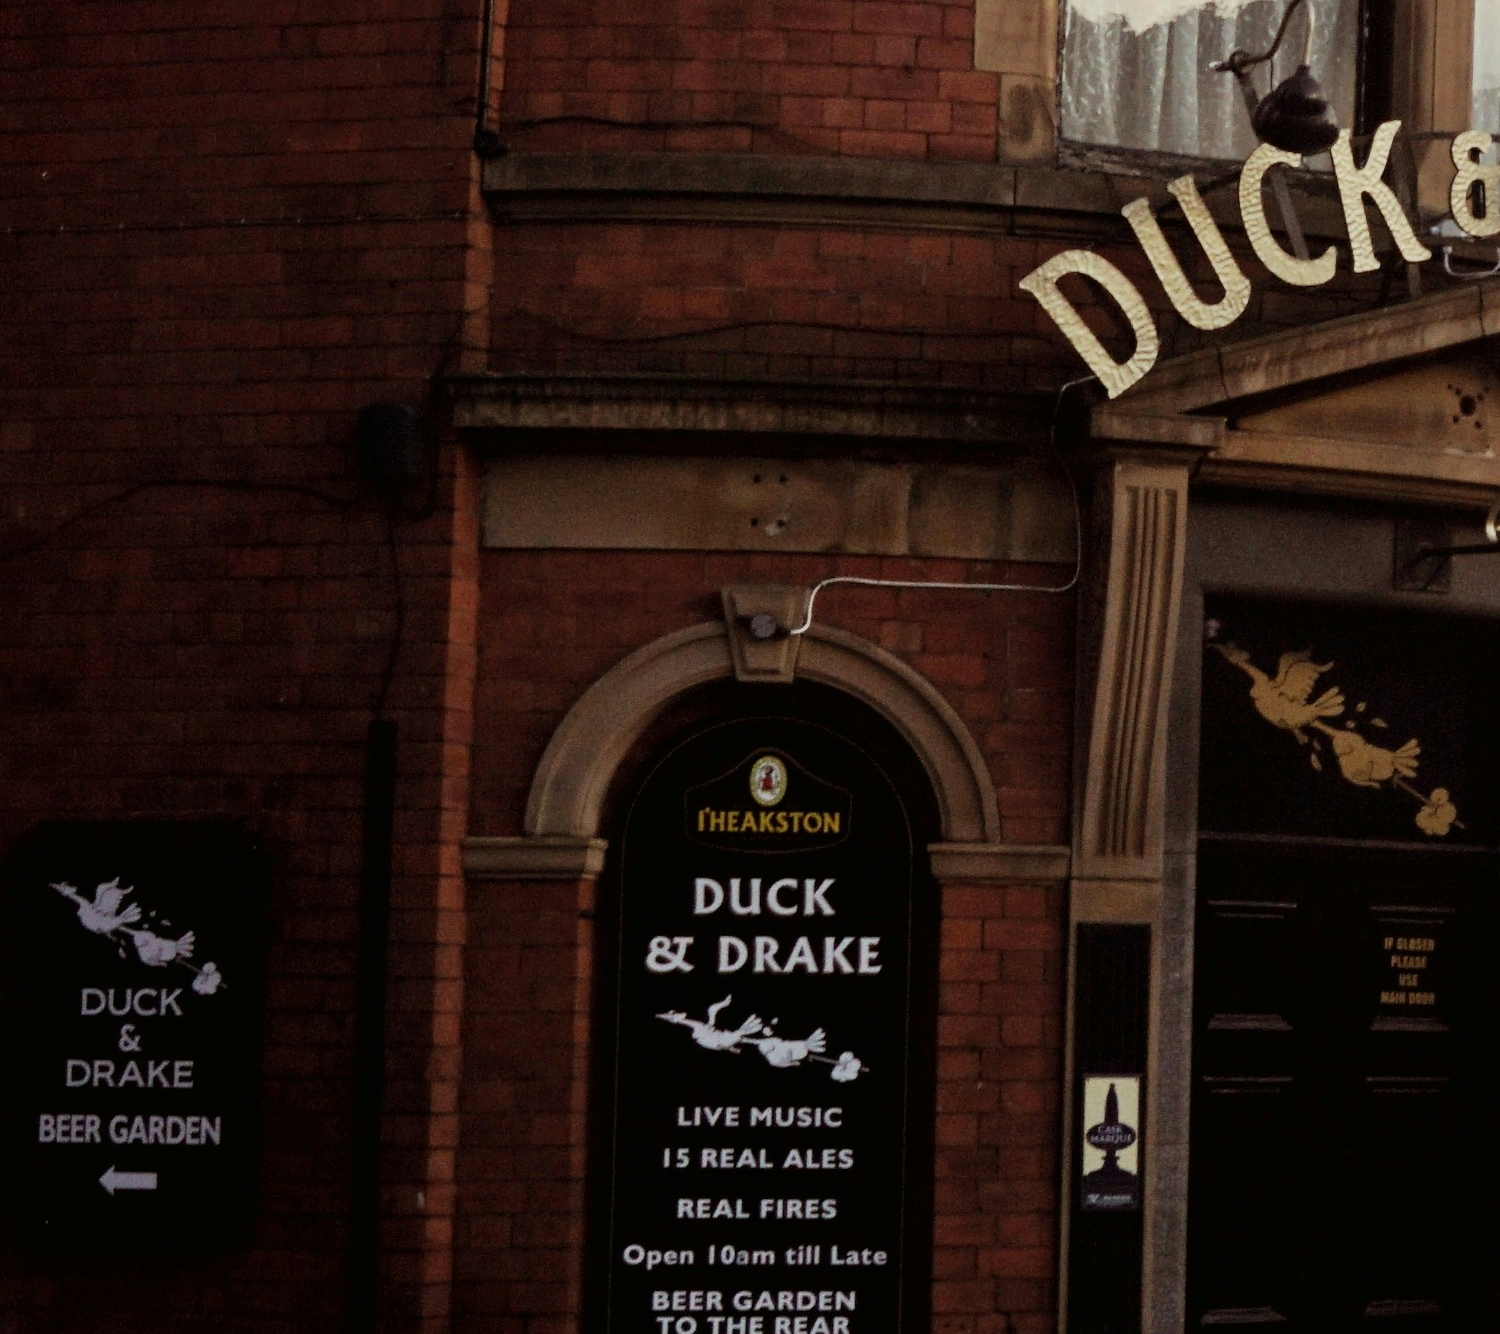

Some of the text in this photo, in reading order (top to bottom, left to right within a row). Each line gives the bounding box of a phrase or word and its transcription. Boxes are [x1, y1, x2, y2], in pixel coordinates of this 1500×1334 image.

[1019, 120, 1432, 399] DUCK
[697, 806, 841, 834] THEAKSTON
[692, 876, 836, 916] DUCK
[644, 934, 883, 975] & DRAKE
[1391, 955, 1427, 969] PLEASE
[1399, 973, 1419, 987] USE
[81, 988, 183, 1016] DUCK
[118, 1023, 142, 1052] &
[65, 1059, 194, 1088] DRAKE
[39, 1114, 221, 1145] BEER GARDEN
[677, 1106, 843, 1128] LIVE MUSIC
[662, 1147, 854, 1169] 15 REAL ALES
[677, 1198, 838, 1219] REAL FIRES
[623, 1244, 888, 1270] Open 10am till Late
[652, 1290, 857, 1312] BEER GARDEN
